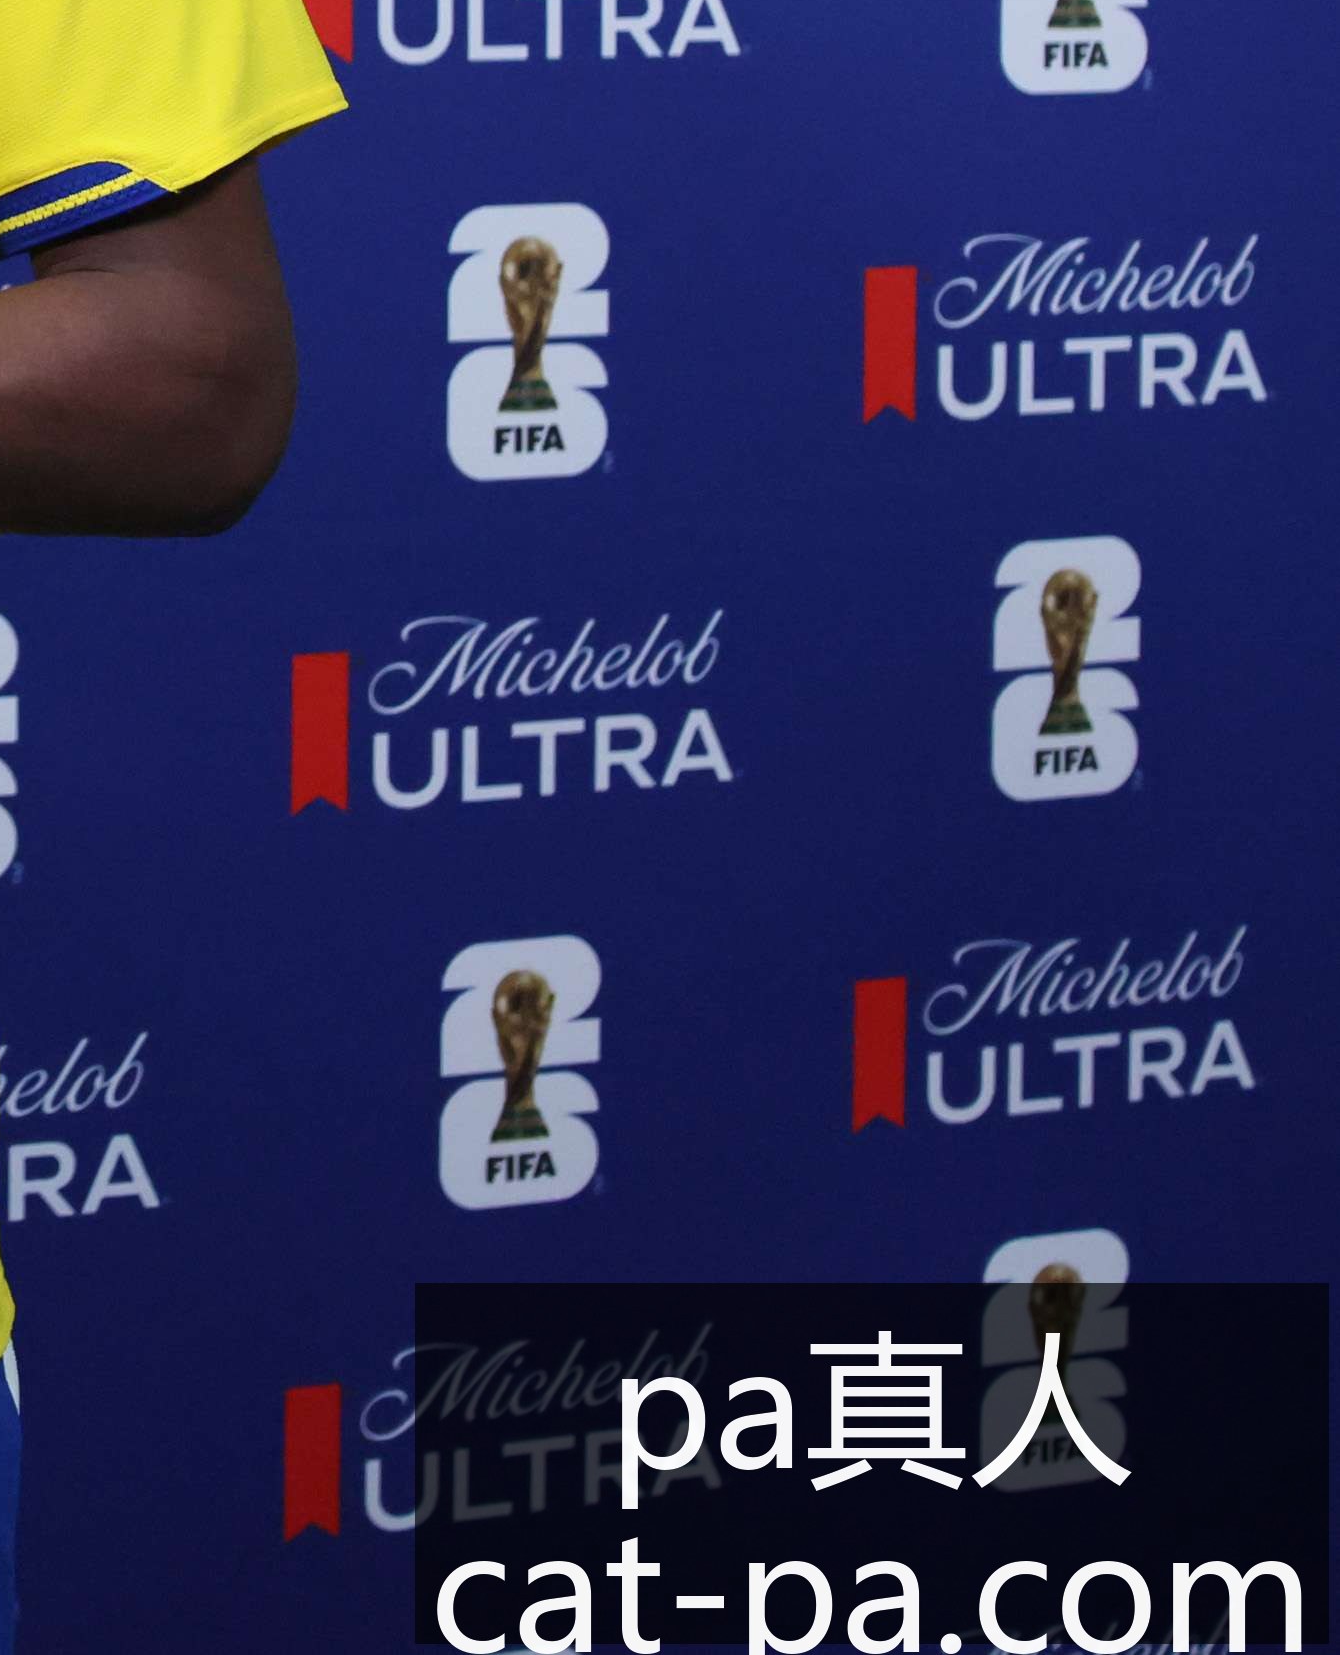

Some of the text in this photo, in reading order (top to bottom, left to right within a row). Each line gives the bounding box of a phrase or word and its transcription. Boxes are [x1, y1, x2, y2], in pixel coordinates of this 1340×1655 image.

[1045, 43, 1107, 67] FIFA
[935, 234, 1257, 328] Michelob
[938, 330, 1266, 420] ULTRA
[495, 426, 564, 453] FIFA
[369, 610, 722, 714] Michelob
[373, 709, 732, 809] ULTRA
[1035, 747, 1097, 775] FIFA
[924, 926, 1246, 1035] Michelob
[927, 1020, 1254, 1123] ULTRA
[486, 1152, 555, 1183] FIFA
